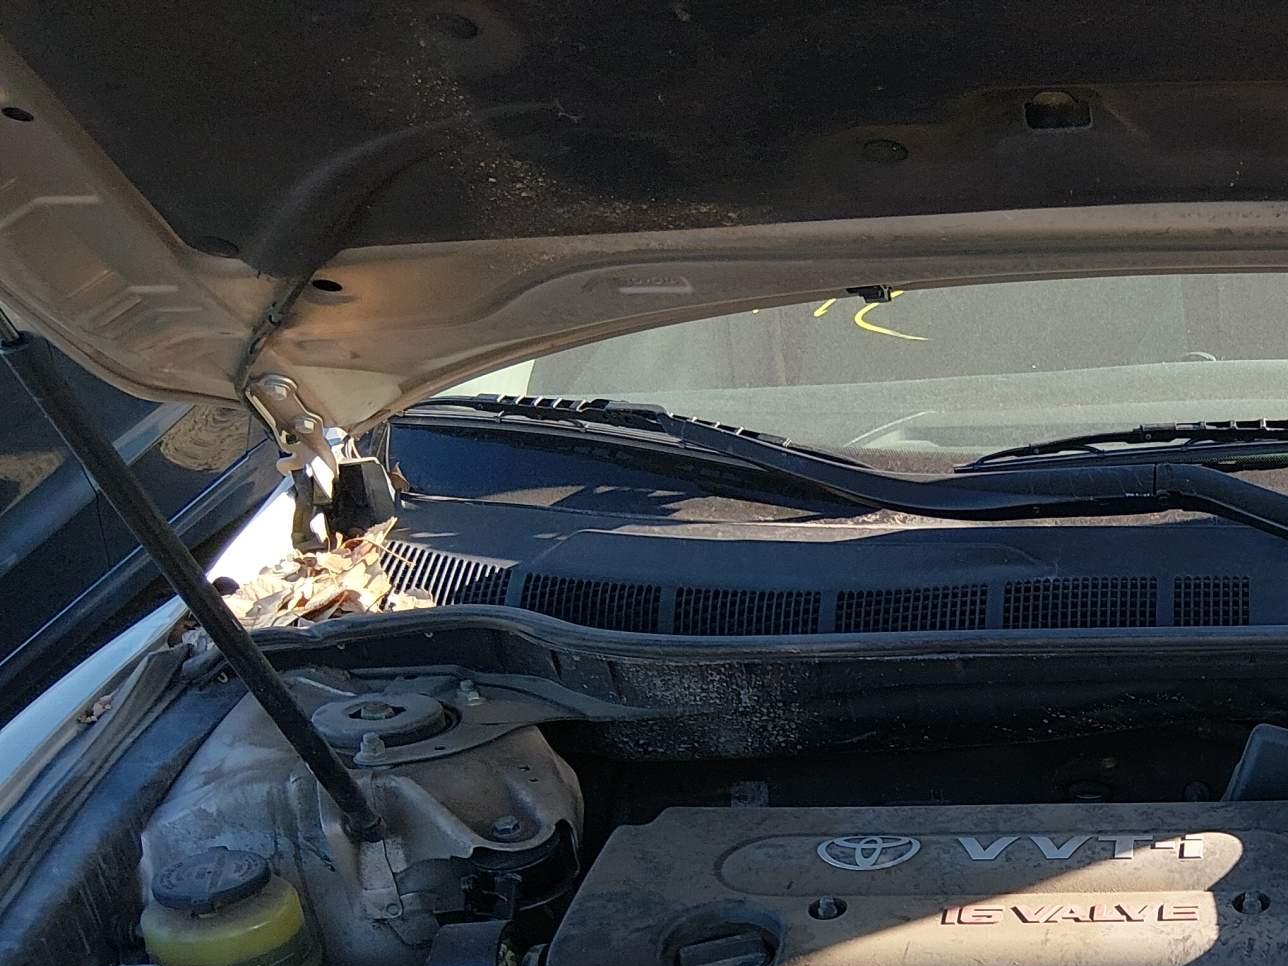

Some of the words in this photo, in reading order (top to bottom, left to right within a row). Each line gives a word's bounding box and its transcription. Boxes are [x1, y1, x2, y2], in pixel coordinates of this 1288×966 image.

[957, 833, 1203, 860] VVT-i
[940, 904, 1003, 926] 16
[1009, 903, 1200, 924] VALVE
